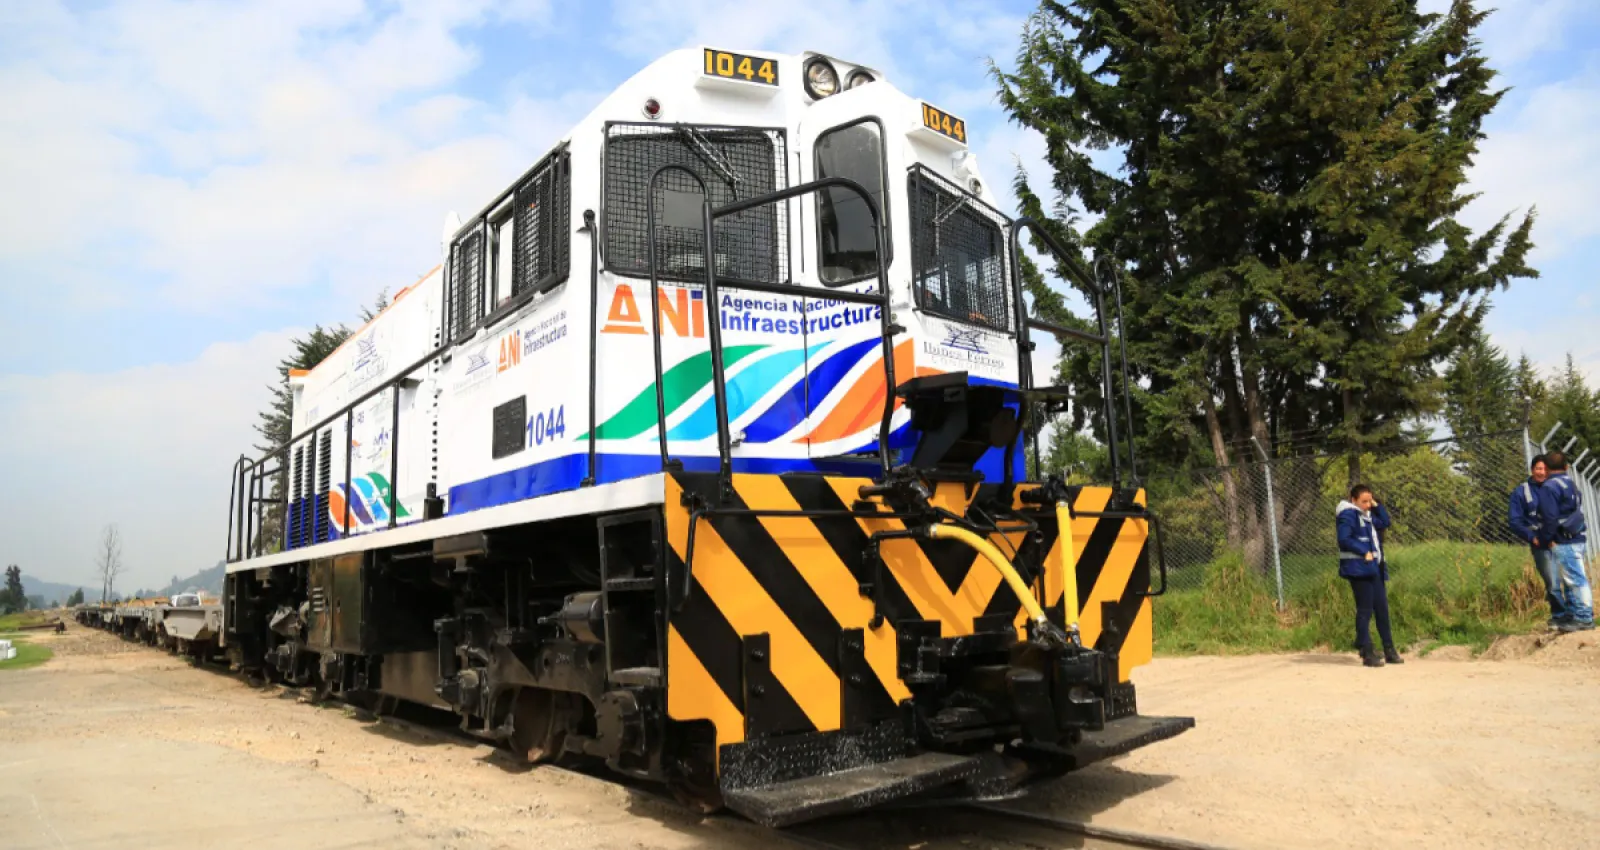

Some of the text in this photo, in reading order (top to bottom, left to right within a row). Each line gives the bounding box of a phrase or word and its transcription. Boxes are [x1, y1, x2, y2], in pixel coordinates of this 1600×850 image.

[705, 49, 776, 84] 1044
[923, 105, 965, 142] 1044
[721, 294, 788, 312] Agencia
[793, 287, 859, 314] Nacion
[527, 404, 565, 448] 1044
